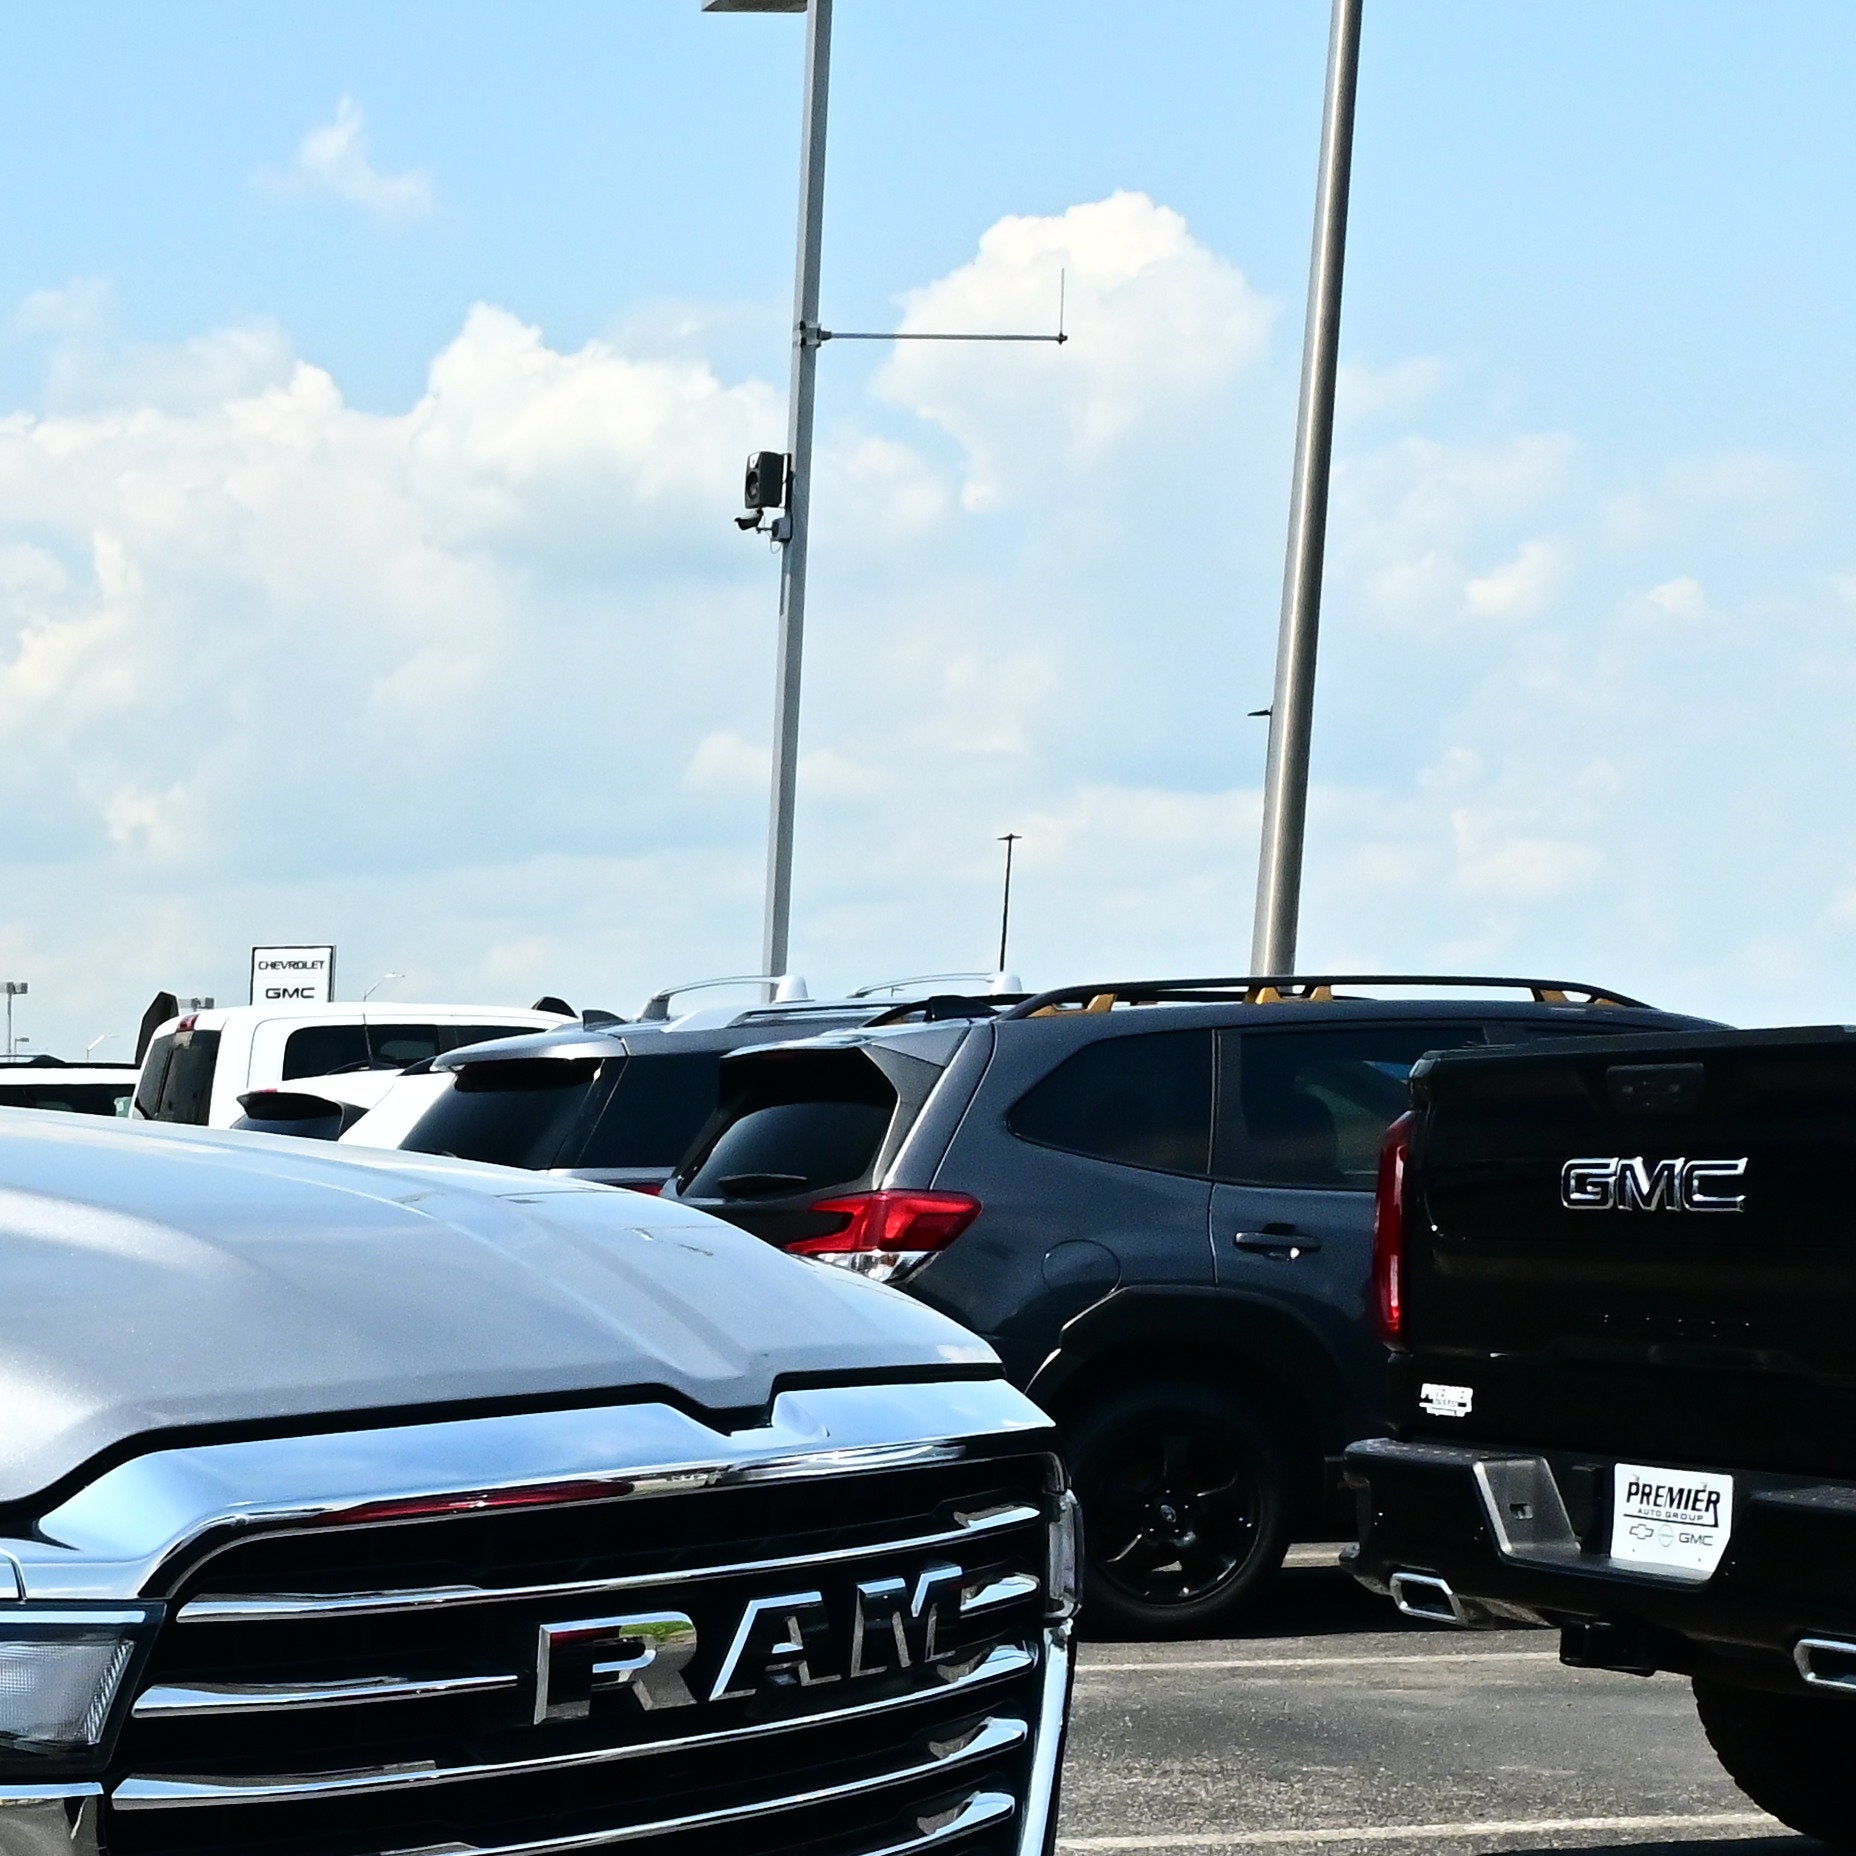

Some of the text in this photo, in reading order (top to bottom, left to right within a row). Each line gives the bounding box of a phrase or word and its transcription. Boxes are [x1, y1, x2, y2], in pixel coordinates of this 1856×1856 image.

[258, 960, 325, 970] CHEVROLET
[265, 987, 315, 999] GMC
[1561, 1156, 1748, 1212] GMC
[1626, 1481, 1721, 1514] PREMIER
[1638, 1508, 1704, 1521] AUTO GROUP
[1678, 1532, 1713, 1546] GMC
[534, 1562, 963, 1726] RAM
